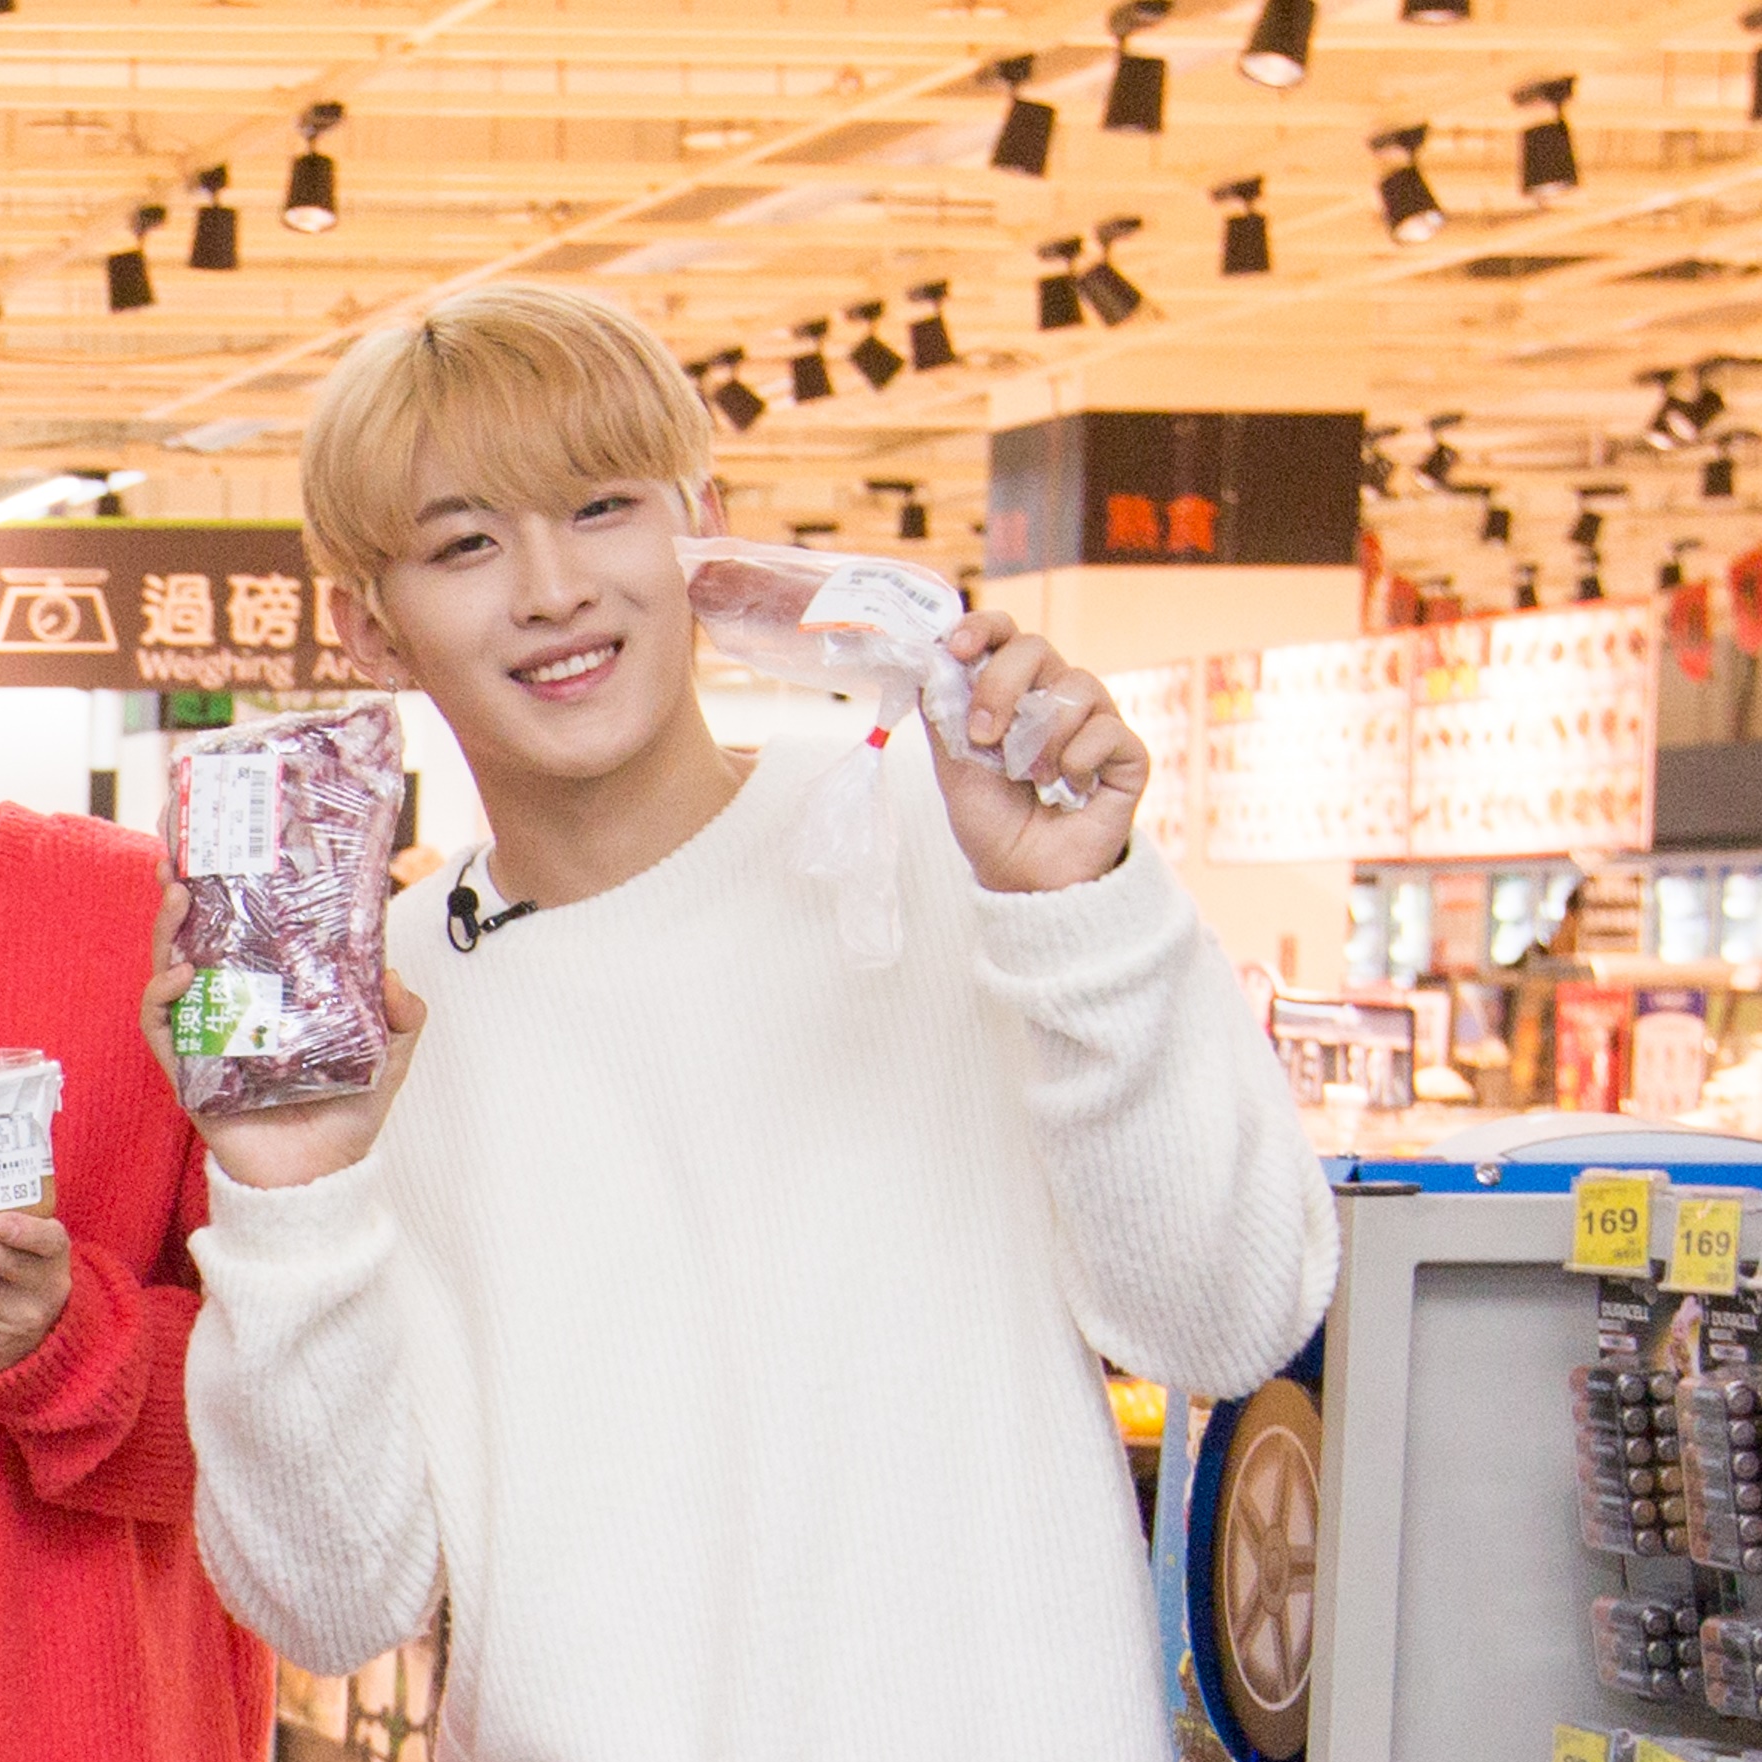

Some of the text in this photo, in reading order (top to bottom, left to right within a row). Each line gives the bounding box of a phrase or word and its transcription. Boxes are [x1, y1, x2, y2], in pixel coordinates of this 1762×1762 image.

[136, 647, 296, 689] Weighing
[1582, 1207, 1639, 1236] 169
[1680, 1229, 1732, 1257] 169
